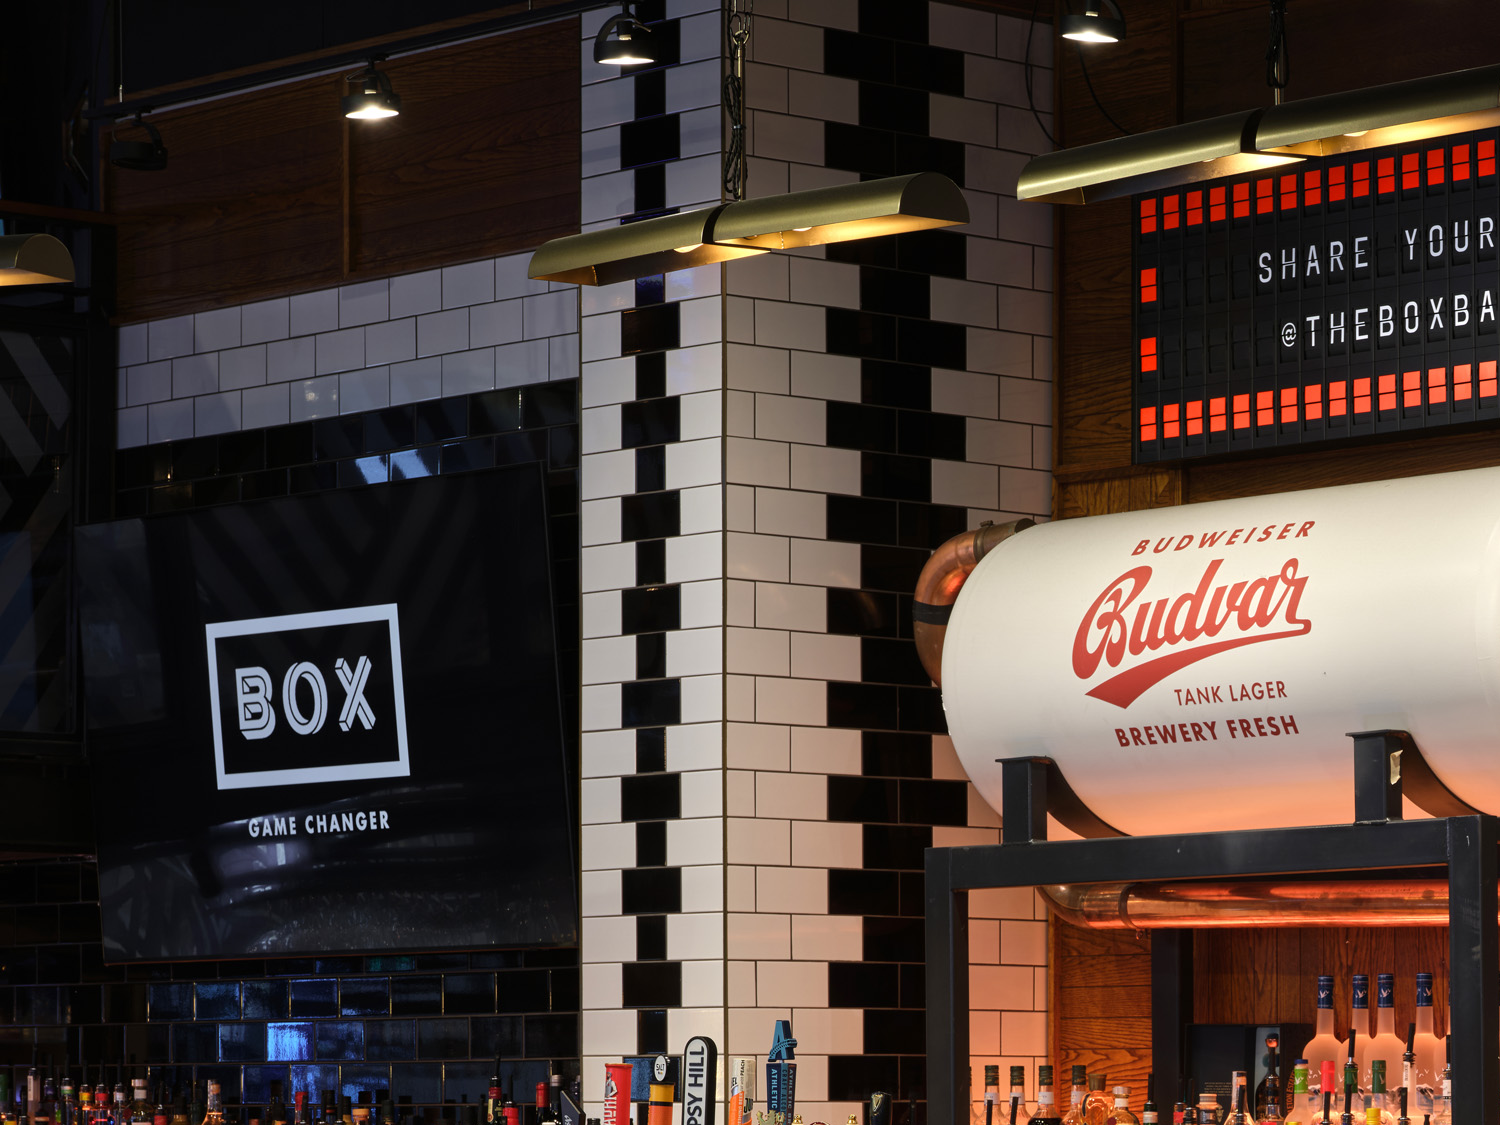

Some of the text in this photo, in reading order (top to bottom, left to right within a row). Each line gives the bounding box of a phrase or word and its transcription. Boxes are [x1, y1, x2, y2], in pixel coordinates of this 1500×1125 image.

[1257, 235, 1370, 285] SHARE
[1403, 216, 1496, 262] YOUR
[1131, 520, 1316, 556] BUDWEISER
[1071, 557, 1313, 682] Budvar
[234, 655, 377, 741] BOX
[1174, 680, 1288, 707] TANK LAGER
[1114, 715, 1300, 748] BREWERY FRESH
[248, 810, 390, 838] GAME CHANGER
[656, 1064, 665, 1072] SALT
[688, 1046, 704, 1088] HILL
